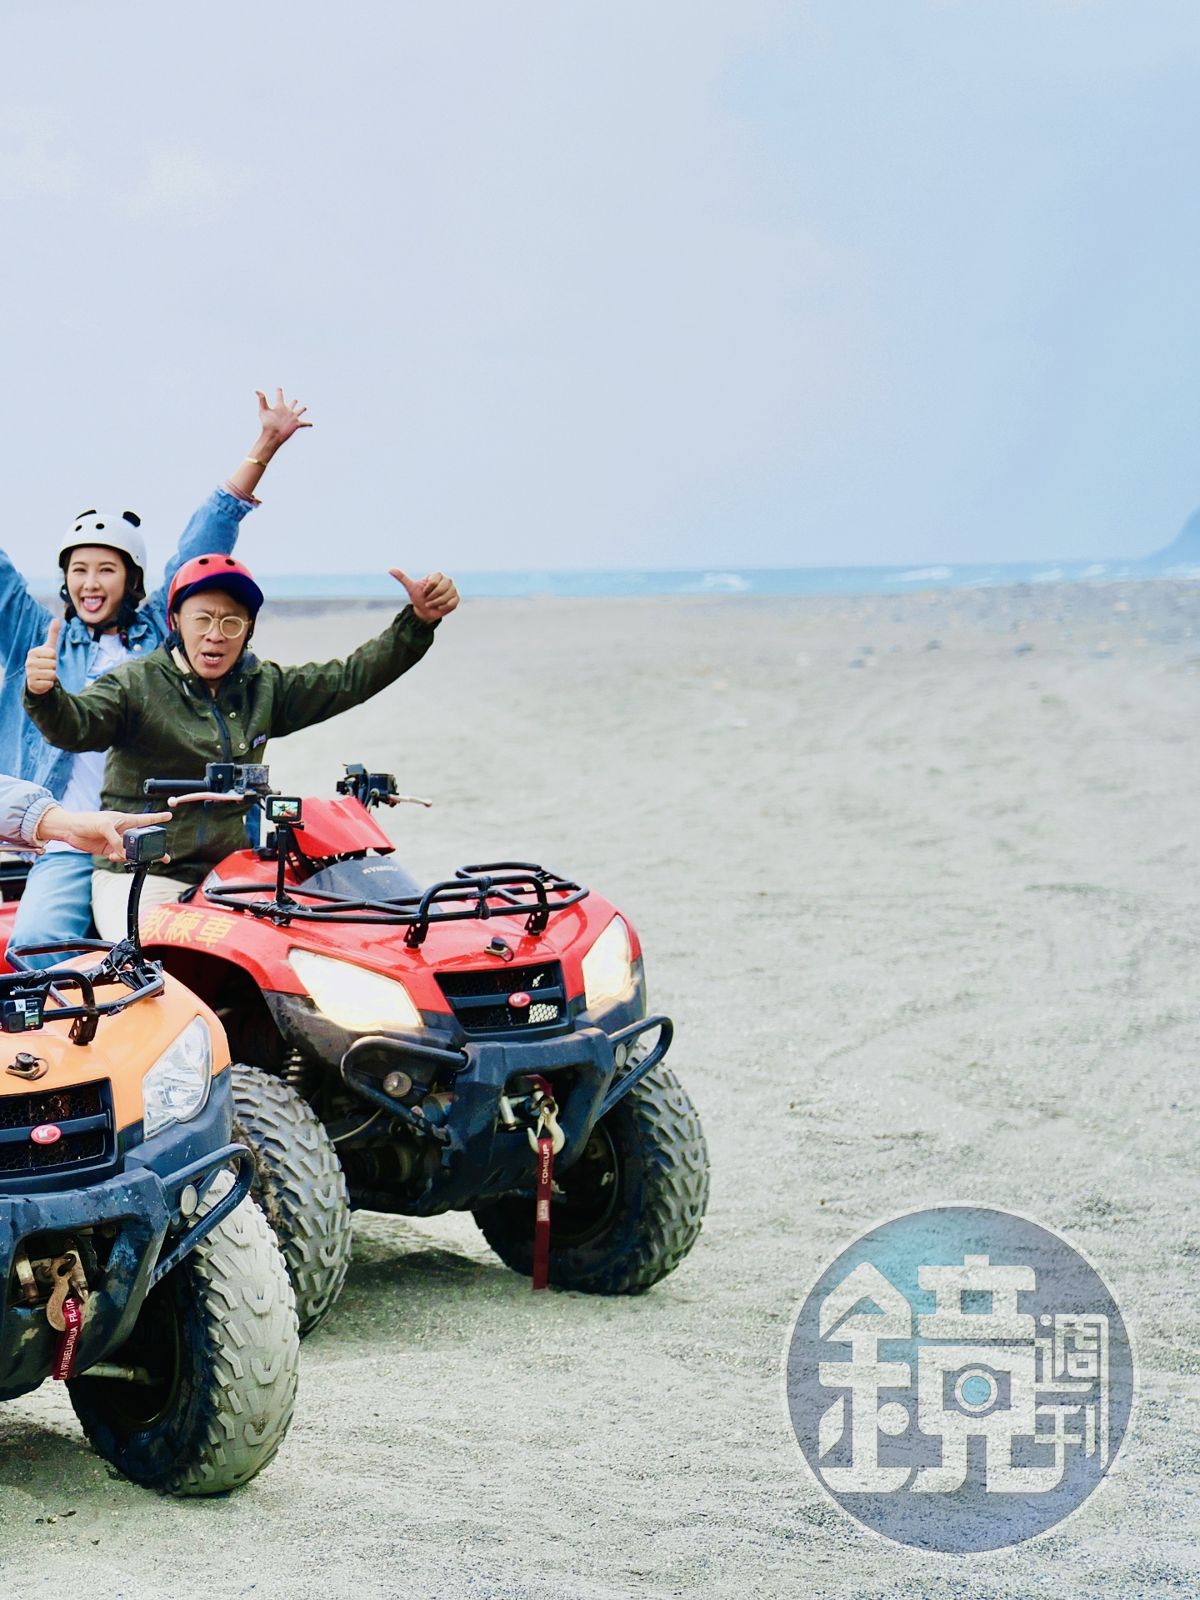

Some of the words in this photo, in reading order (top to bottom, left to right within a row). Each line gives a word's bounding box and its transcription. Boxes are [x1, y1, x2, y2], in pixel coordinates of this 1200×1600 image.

[140, 907, 237, 948] 教練車
[542, 1144, 550, 1184] COMEUP
